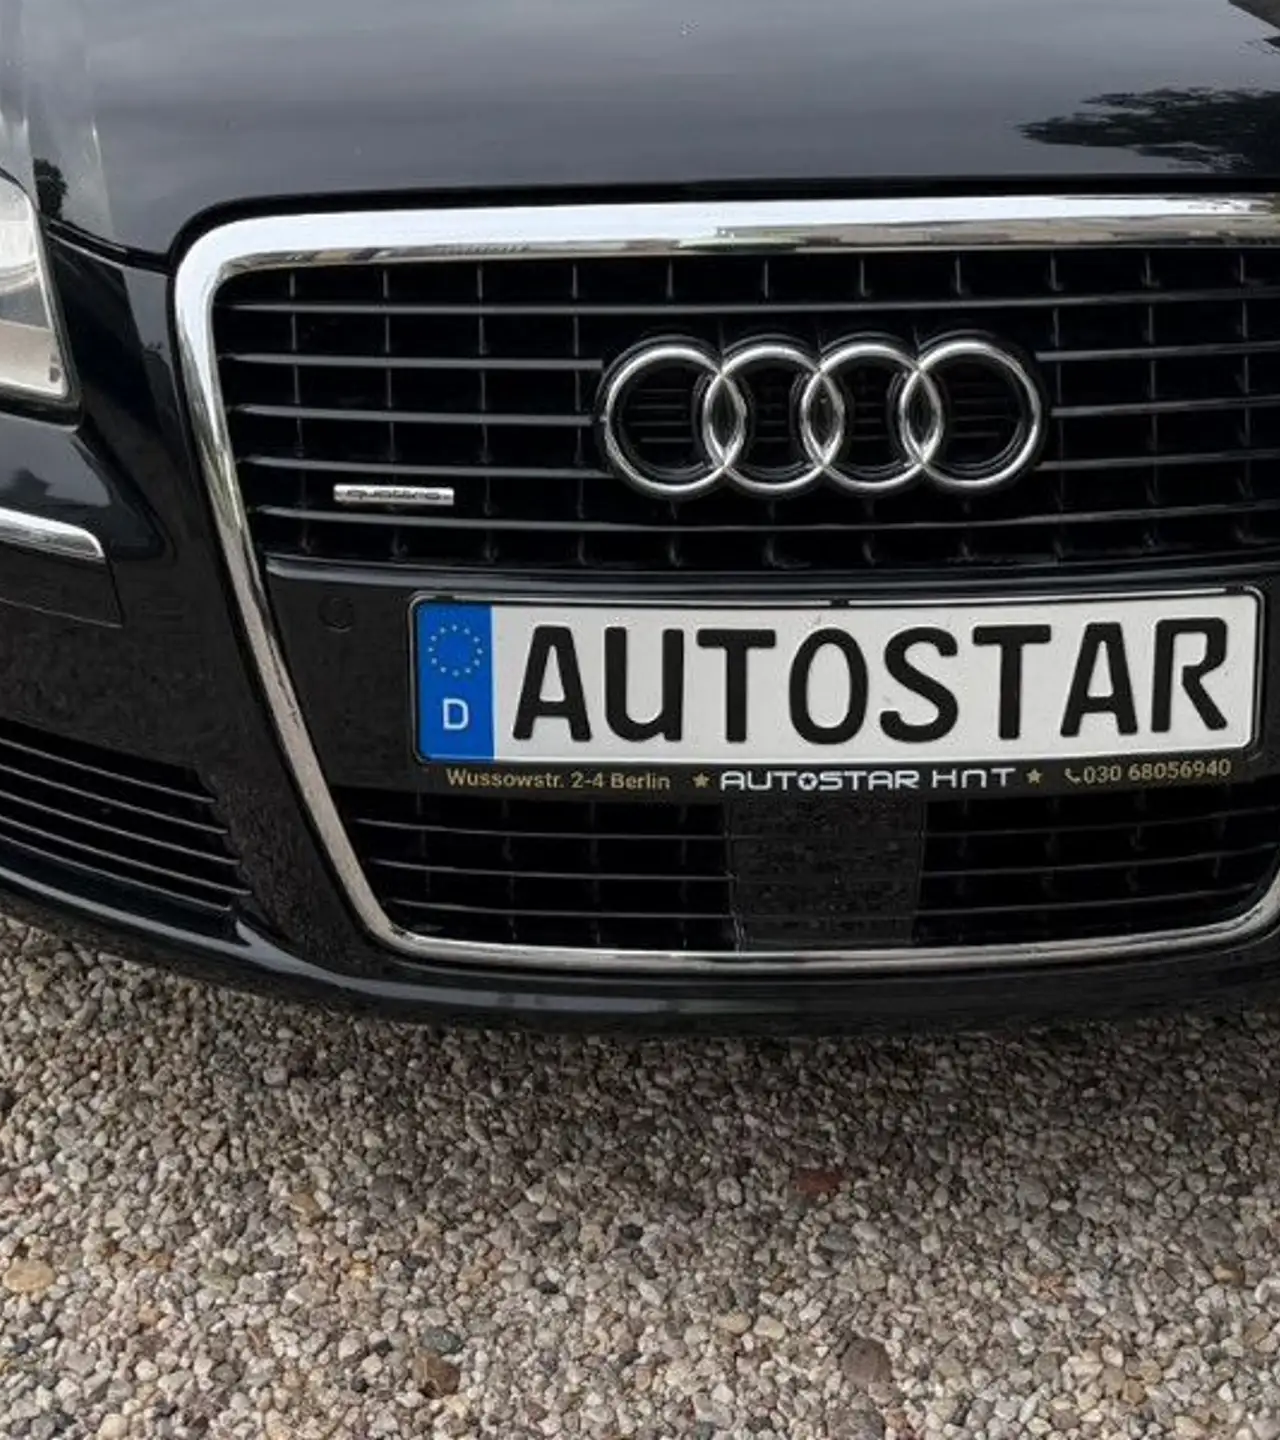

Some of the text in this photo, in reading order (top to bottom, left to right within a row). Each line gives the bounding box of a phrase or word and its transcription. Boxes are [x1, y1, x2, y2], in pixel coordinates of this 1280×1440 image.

[443, 618, 1228, 744] D AUTOSTAR
[446, 768, 564, 789] Wussowstr.
[573, 774, 604, 789] 2-4
[611, 773, 671, 791] Berlin
[720, 769, 920, 792] AUTOSTAR
[1083, 765, 1121, 784] 030
[1128, 759, 1232, 782] 68056940
